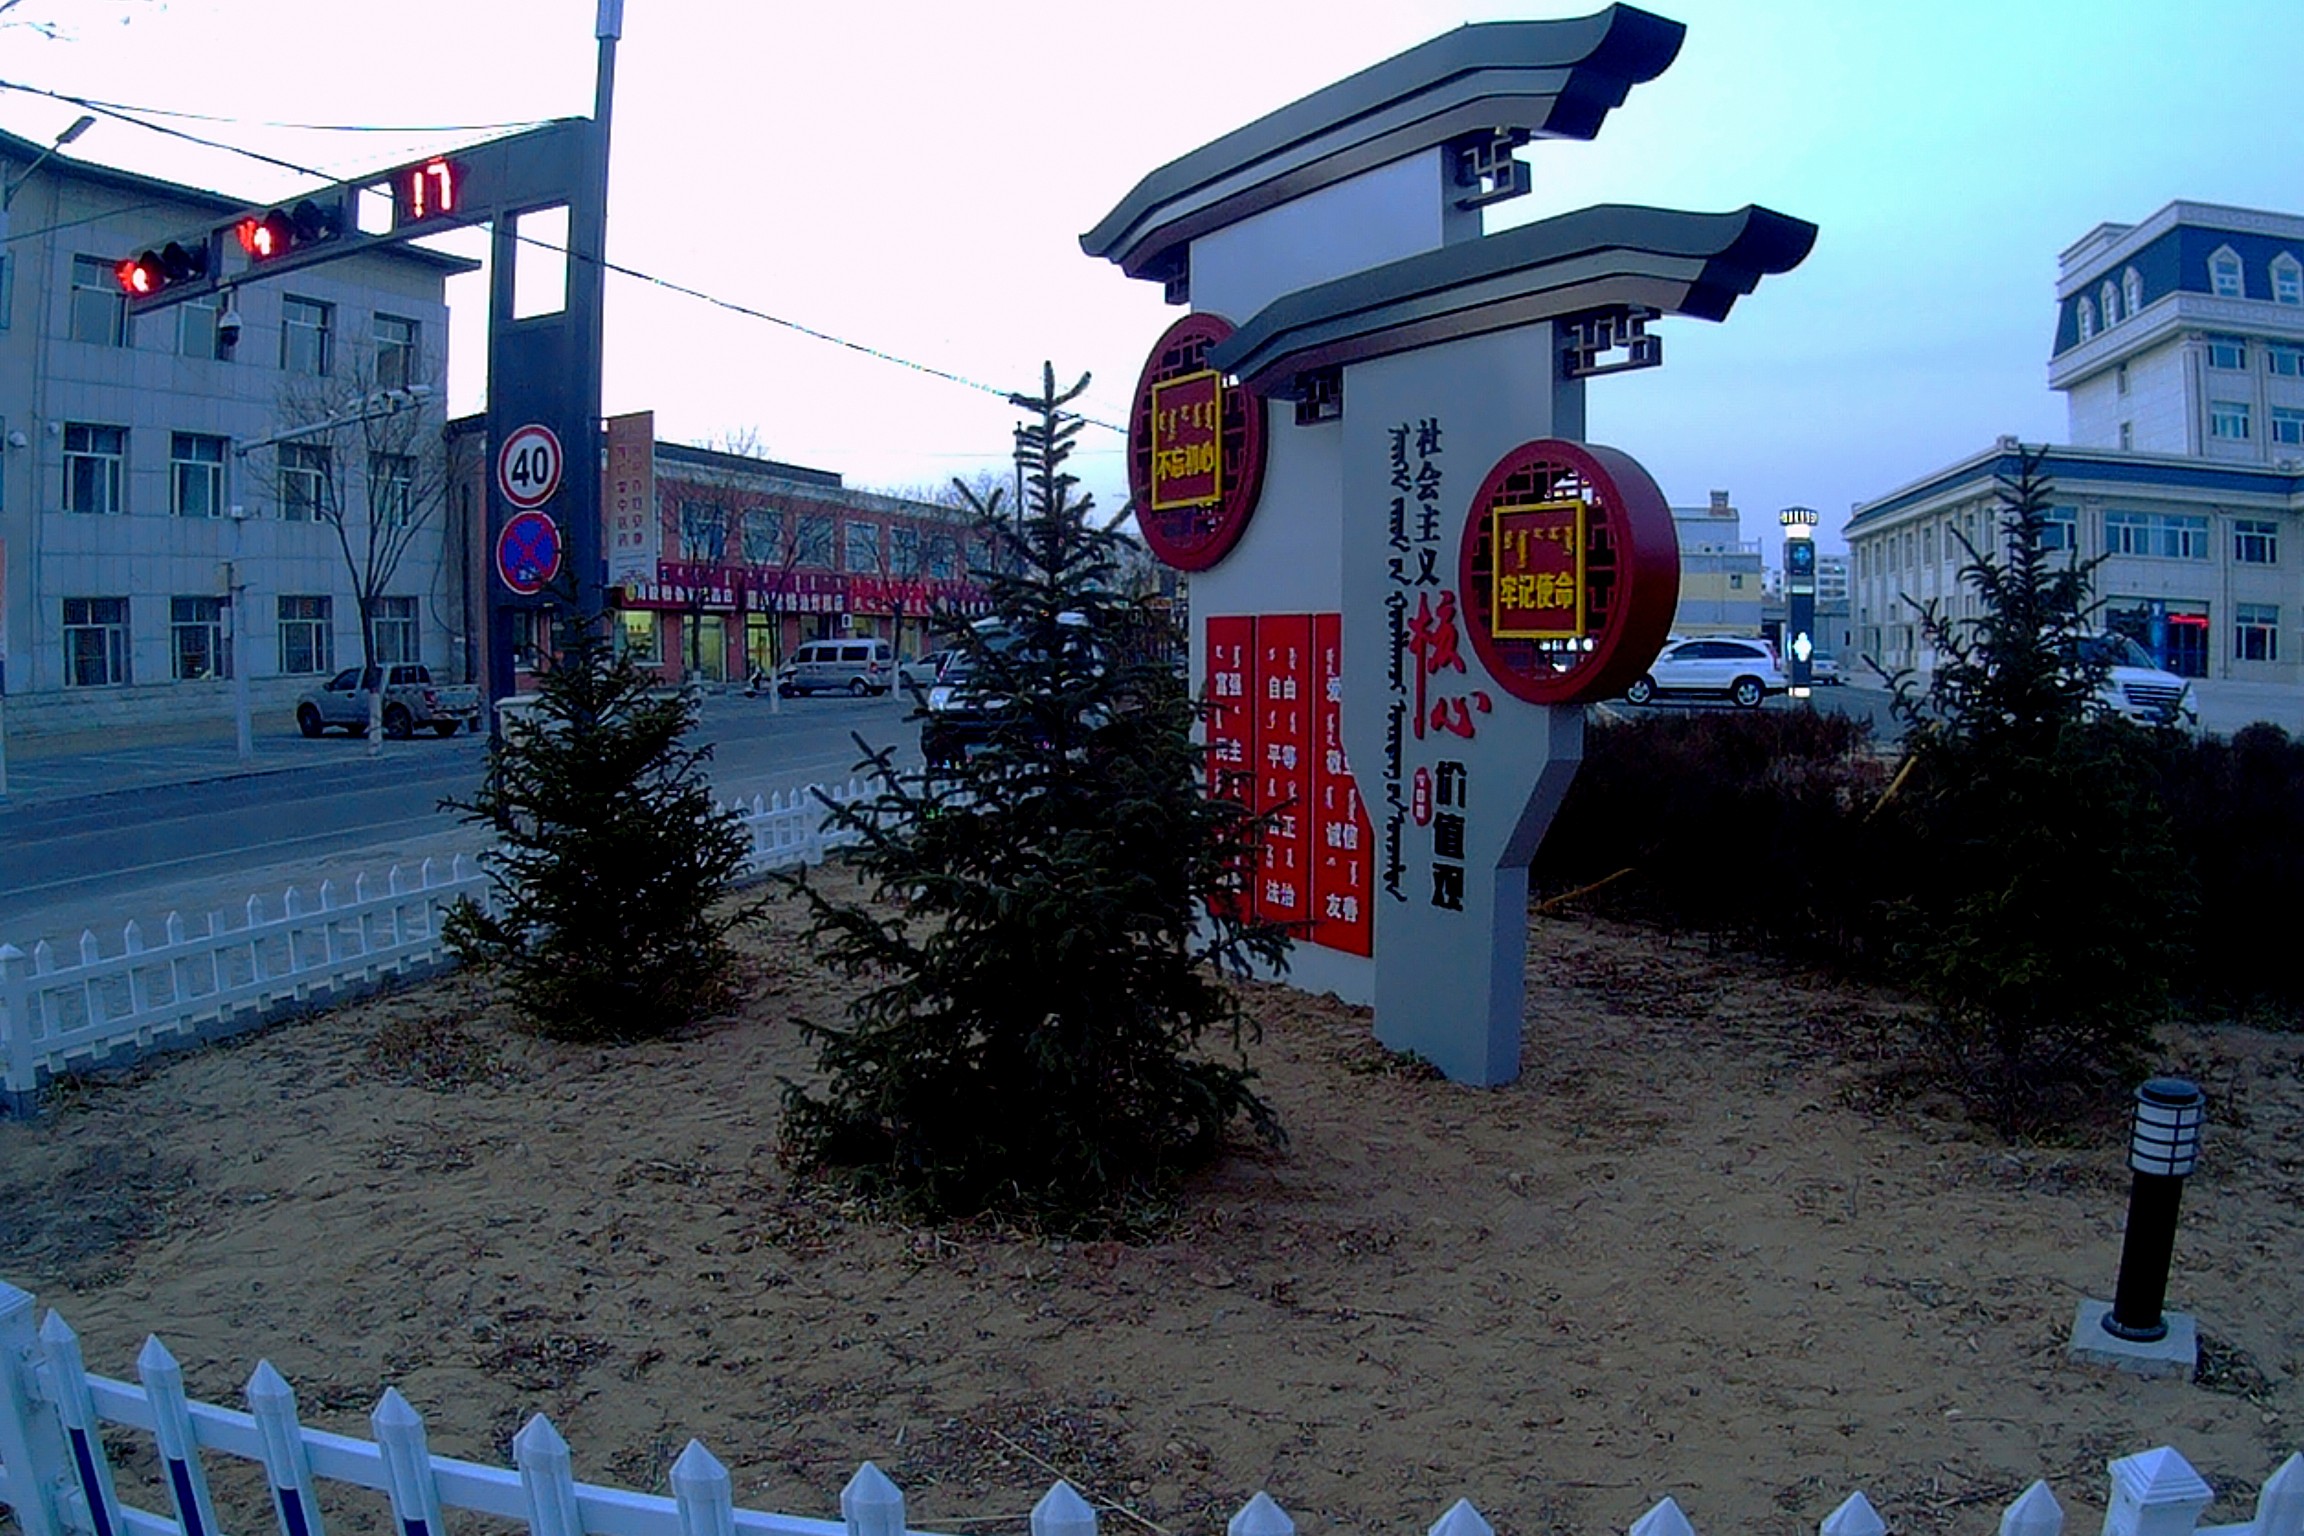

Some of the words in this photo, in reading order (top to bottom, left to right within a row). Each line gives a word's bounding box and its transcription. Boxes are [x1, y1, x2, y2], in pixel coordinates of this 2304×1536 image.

[413, 160, 452, 218] 17
[512, 446, 549, 487] 40
[1156, 440, 1216, 481] 不忘初心
[1414, 417, 1443, 586] 社会主义
[1500, 571, 1575, 610] 牢记使命
[1408, 590, 1492, 740] 核心
[1269, 675, 1296, 700] 自由
[1268, 744, 1297, 770] 平等
[1432, 761, 1467, 912] 价值观
[1326, 893, 1358, 922] 友善
